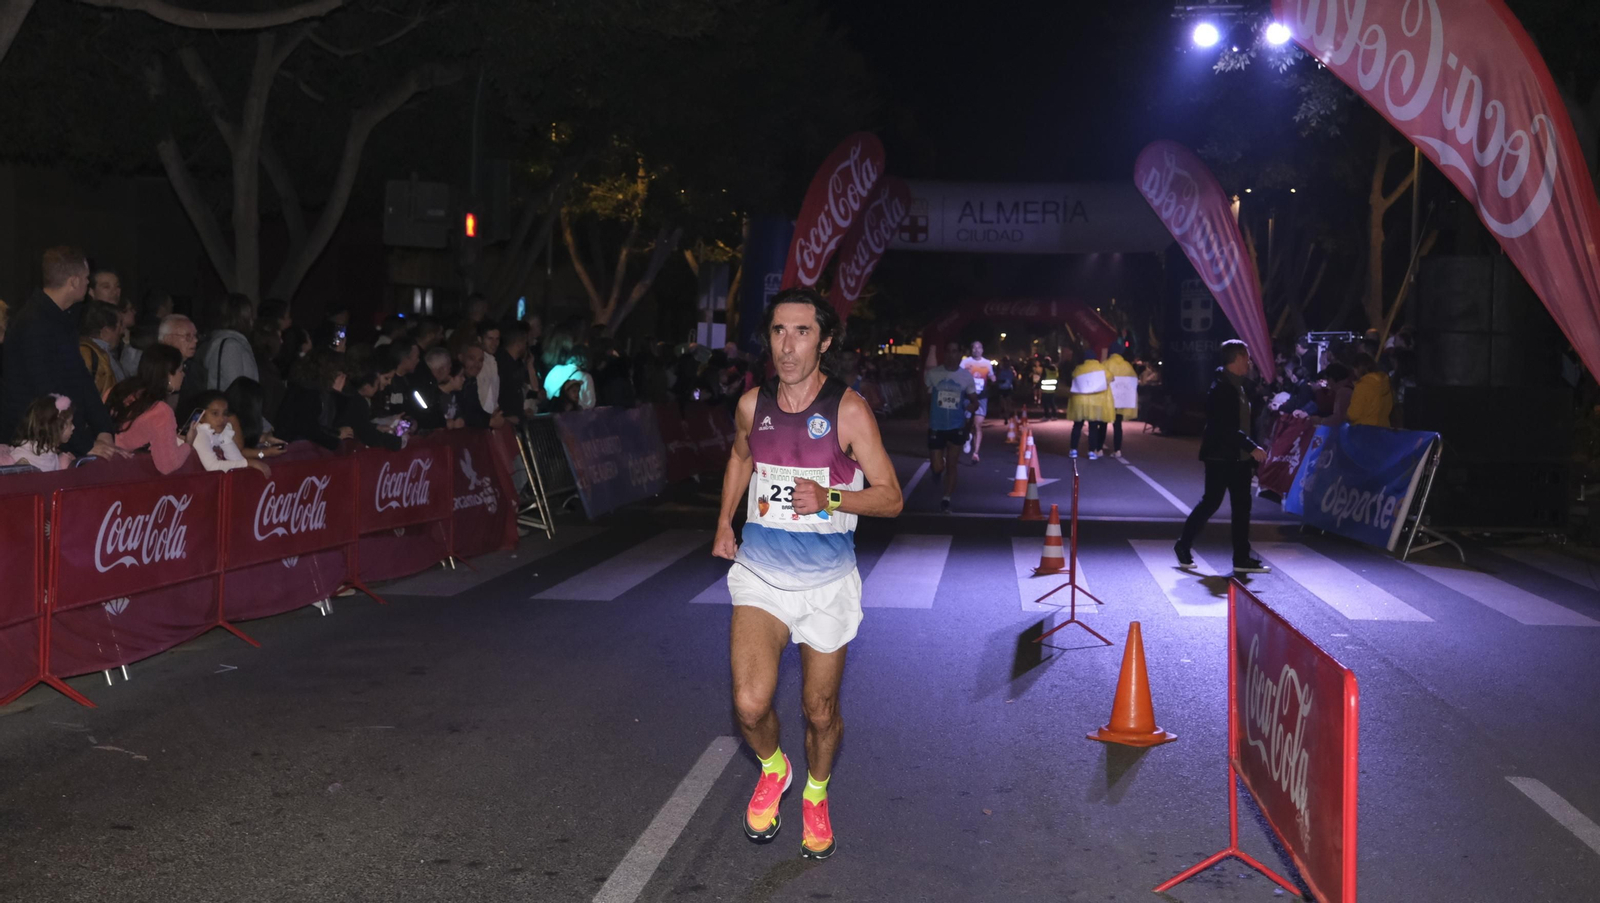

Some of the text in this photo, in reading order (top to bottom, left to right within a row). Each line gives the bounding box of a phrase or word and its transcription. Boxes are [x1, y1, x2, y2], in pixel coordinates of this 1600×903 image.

[796, 139, 878, 286] Coca-Cola
[839, 184, 906, 301] Coca-Cola
[956, 229, 1024, 242] CIUDAD
[957, 195, 1089, 224] ALMERÍA
[253, 475, 331, 541] Coca-Cola
[375, 458, 432, 513] Coca-Cola
[94, 494, 193, 573] Coca-Cola
[1245, 634, 1314, 816] Coca-Cola
